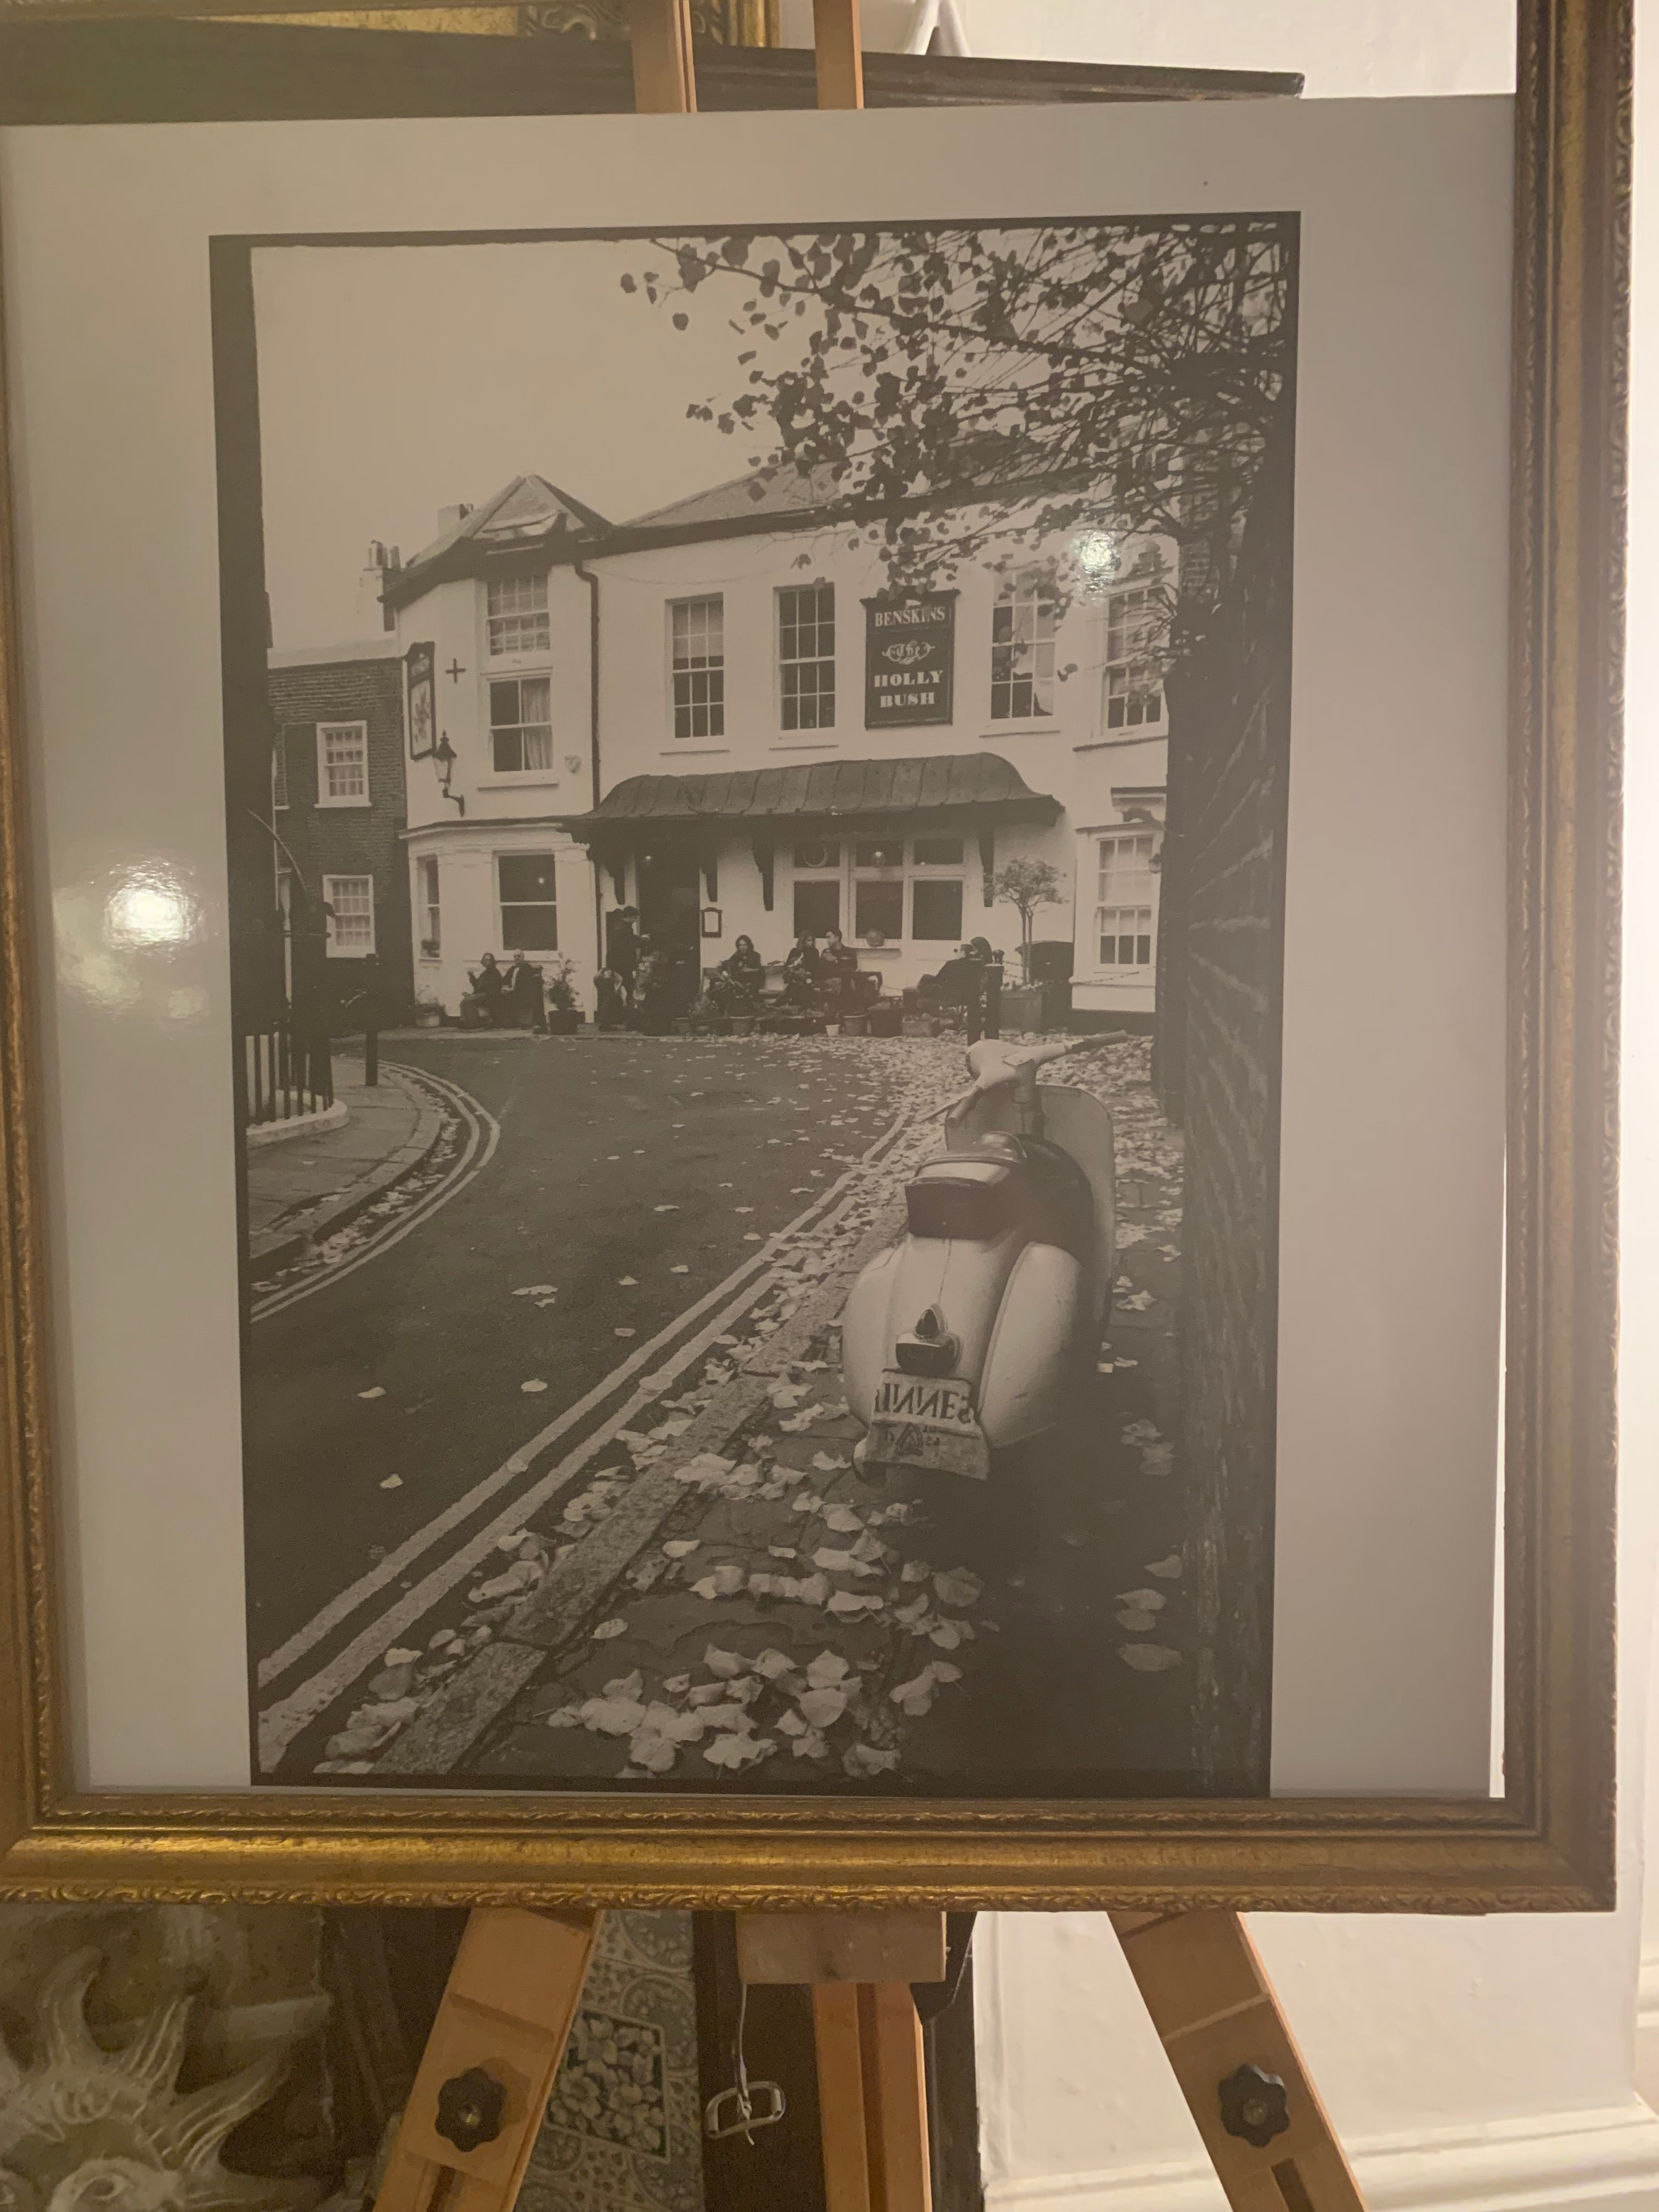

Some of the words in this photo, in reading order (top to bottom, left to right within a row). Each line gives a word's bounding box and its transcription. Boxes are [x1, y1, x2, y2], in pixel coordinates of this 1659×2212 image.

[891, 640, 921, 657] The
[874, 670, 943, 687] HOLLY
[880, 692, 935, 708] BUSH
